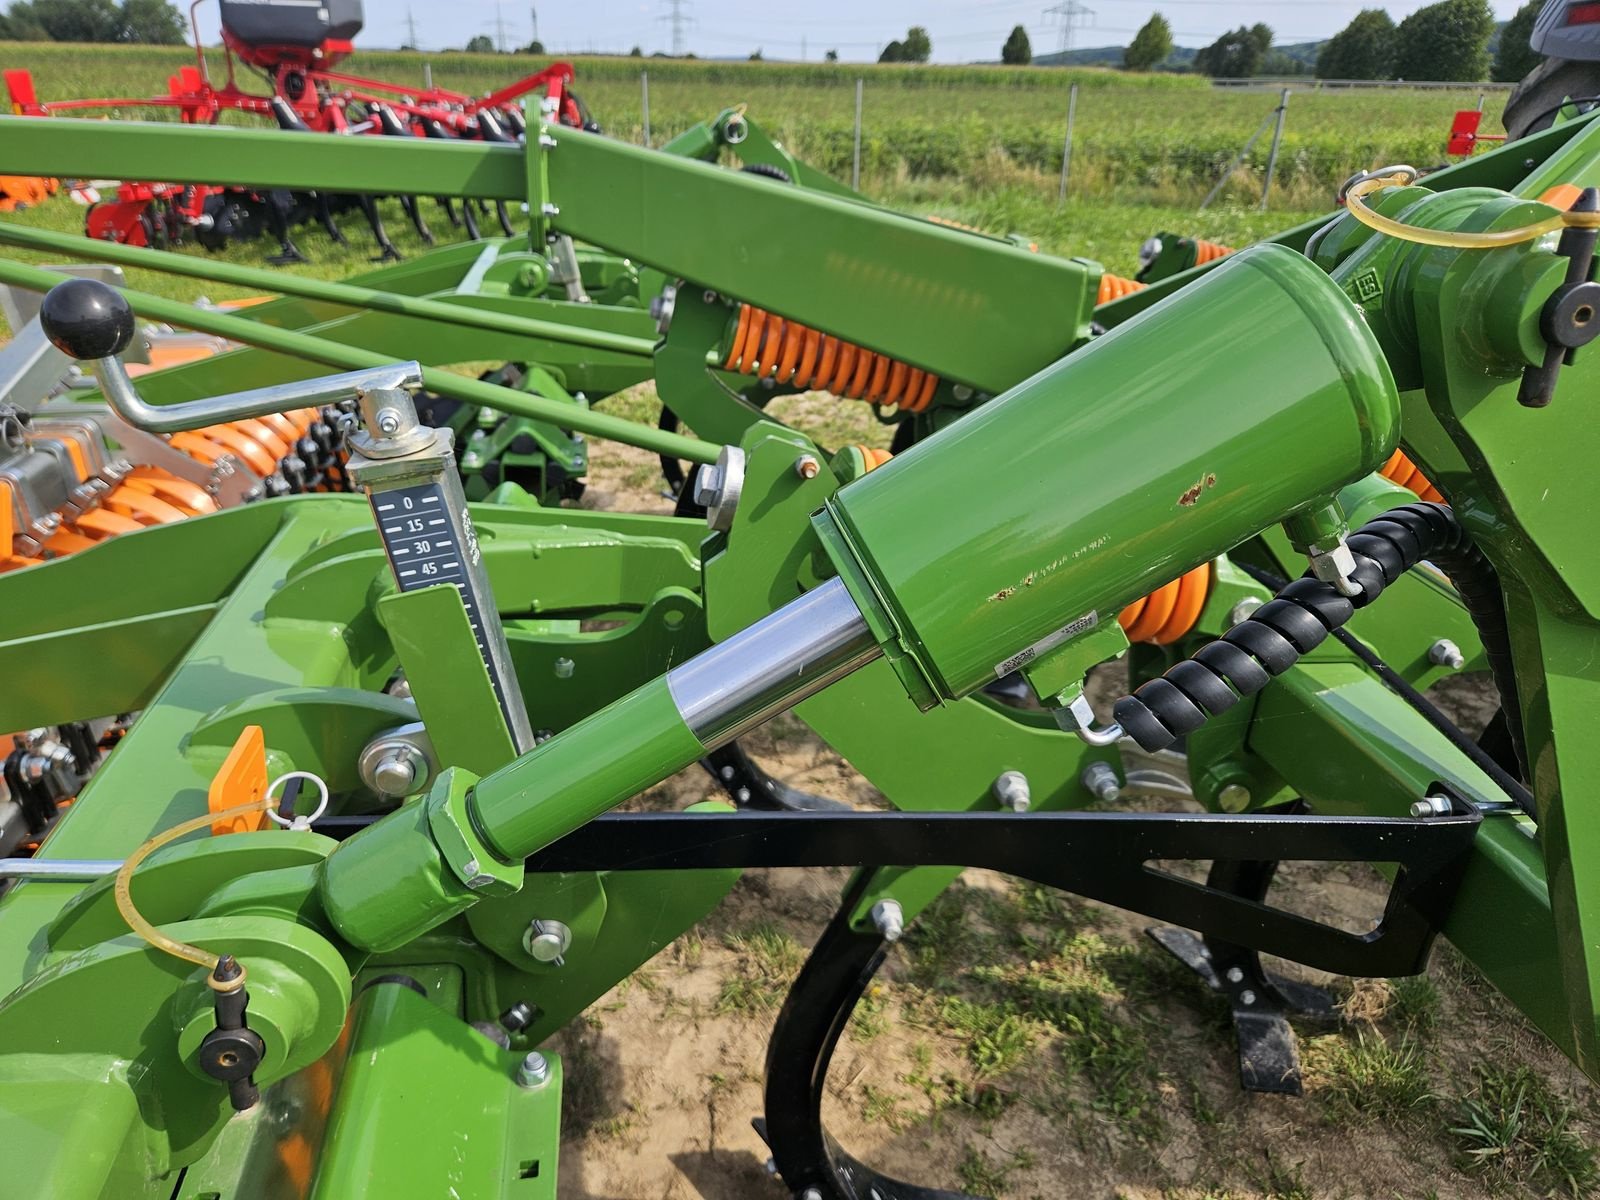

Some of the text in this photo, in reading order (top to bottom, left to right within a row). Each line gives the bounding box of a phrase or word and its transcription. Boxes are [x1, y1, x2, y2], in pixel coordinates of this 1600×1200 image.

[403, 496, 413, 510] 0
[406, 518, 424, 532] 15
[413, 540, 431, 555] 30
[421, 562, 438, 575] 45
